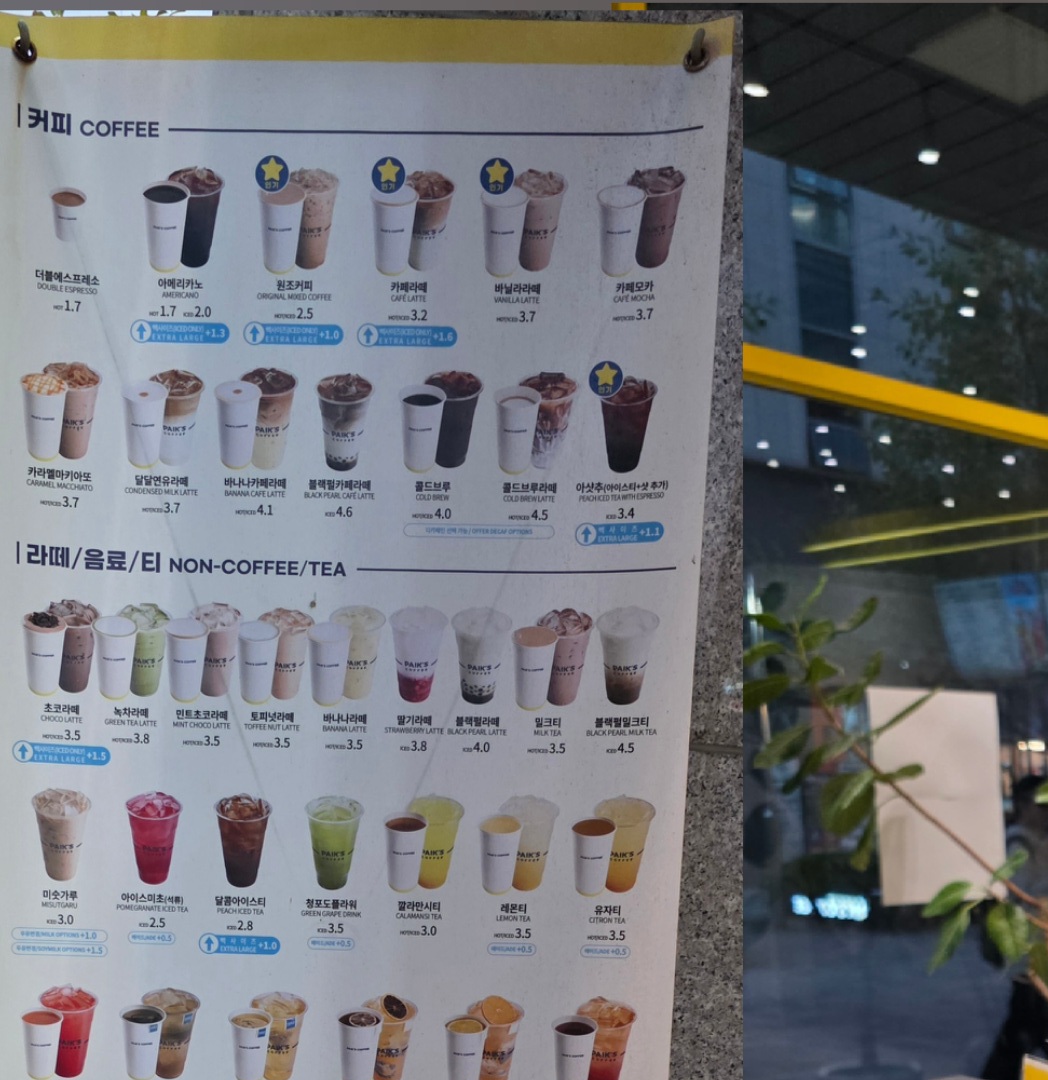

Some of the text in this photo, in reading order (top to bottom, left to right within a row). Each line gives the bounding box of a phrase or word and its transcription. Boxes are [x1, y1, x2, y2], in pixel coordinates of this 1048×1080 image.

[28, 107, 160, 138] 커피 COFFEE
[35, 270, 100, 287] 더블에스프레소
[158, 278, 203, 290] 아메리카노
[277, 279, 313, 292] 원조커피
[391, 282, 427, 294] 카페라떼
[494, 283, 540, 295] 바닐라라떼
[616, 281, 653, 293] 카페모카
[64, 300, 81, 312] 1.7
[297, 308, 313, 319] 2.5
[411, 310, 427, 321] 3.2
[27, 466, 92, 482] 카라멜마키아또
[135, 474, 188, 487] 달달연유라떼
[225, 477, 286, 490] 바나나카페라떼
[308, 478, 371, 492] 블랙펄카페라떼
[415, 480, 451, 492] 콜드브루
[502, 482, 557, 494] 콜드브루라떼
[336, 506, 352, 518] 4.6
[618, 508, 634, 519] 3.4
[27, 543, 346, 577] 라떼/음료/티 NON-COFFEE/TEA
[44, 703, 80, 715] 초코라떼
[113, 707, 149, 718] 녹차라떼
[176, 710, 228, 721] 민트초코라떼
[251, 711, 294, 723] 토피넛라떼
[397, 715, 432, 726] 딸기라떼
[456, 716, 499, 727] 블랙펄라떼
[535, 717, 561, 728] 밀크티
[595, 716, 649, 728] 블랙펄밀크티
[64, 729, 80, 741] 3.5
[42, 890, 78, 901] 미숫가루
[215, 895, 265, 907] 달콤아이스티
[306, 898, 357, 910] 청포도플라워
[398, 901, 441, 912] 깔라만시티
[500, 903, 526, 914] 레몬티
[595, 904, 621, 916] 유자티
